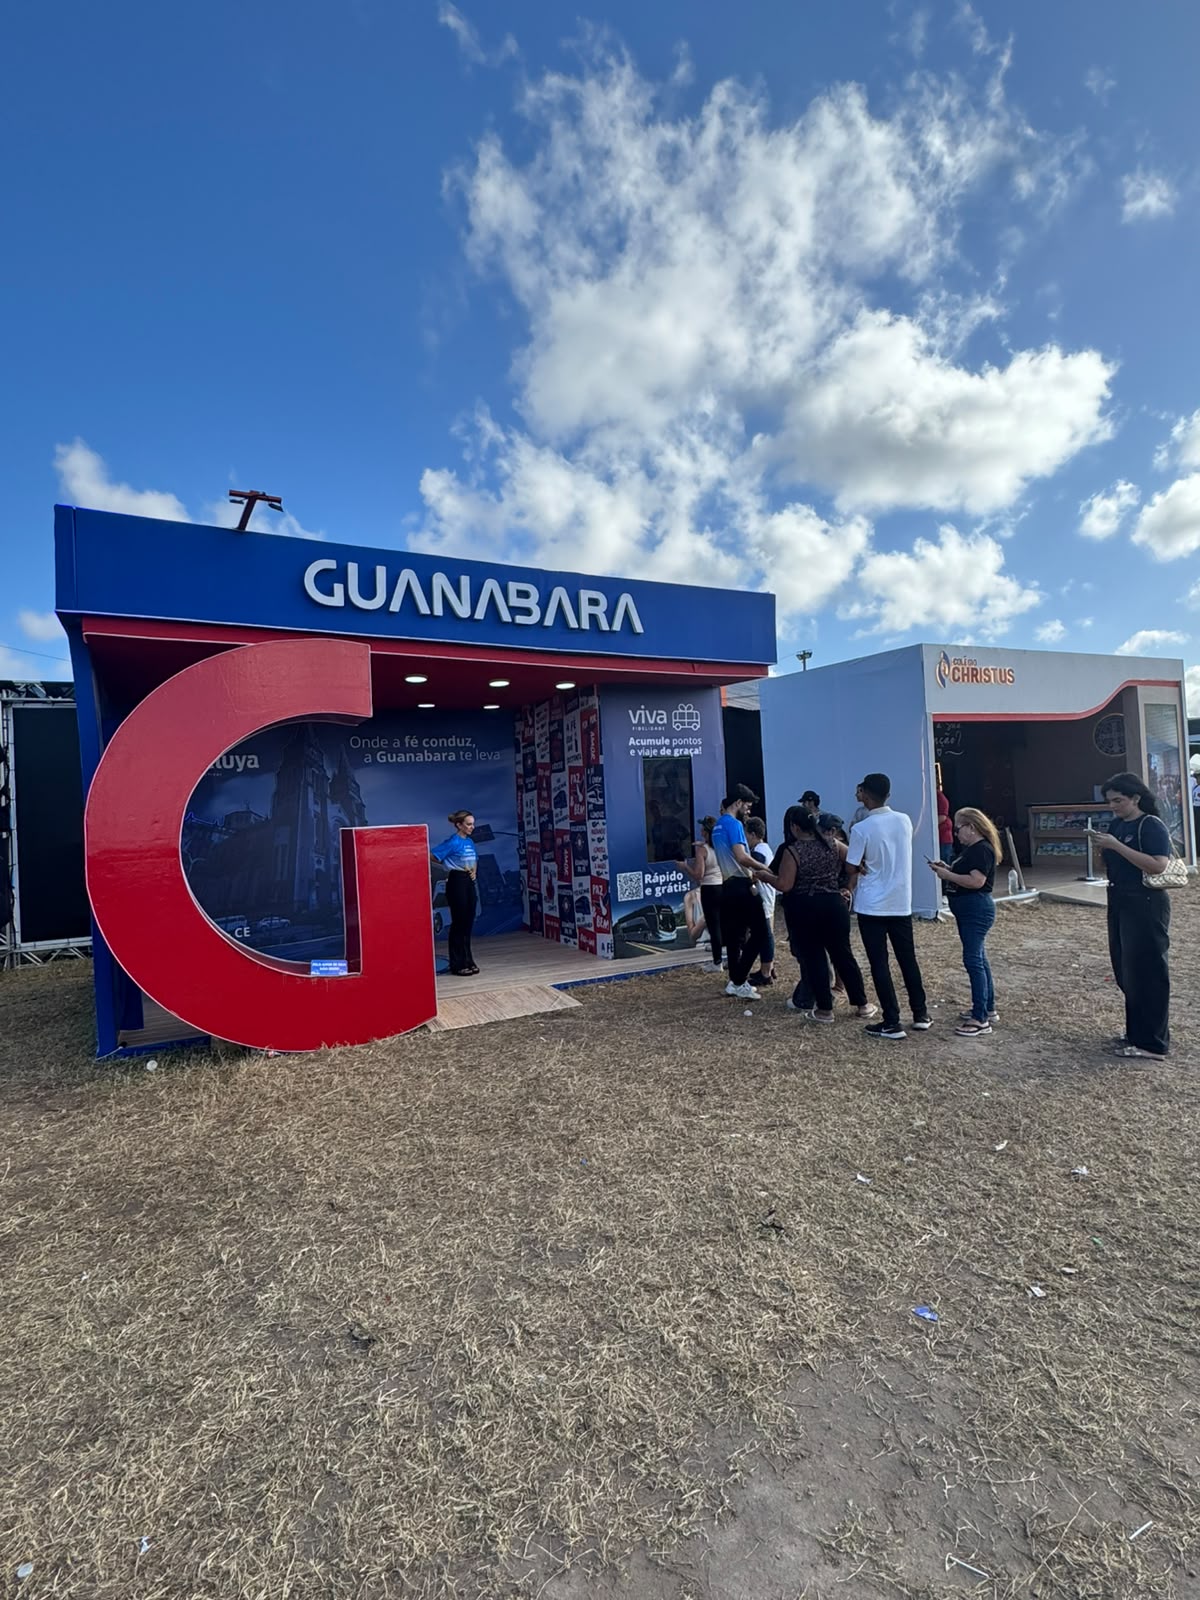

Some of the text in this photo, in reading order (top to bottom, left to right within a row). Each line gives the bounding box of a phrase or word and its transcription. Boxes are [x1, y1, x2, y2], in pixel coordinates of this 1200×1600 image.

[303, 558, 645, 634] GUANABARA
[951, 667, 1016, 685] CHRISTUS
[628, 704, 668, 725] viva
[349, 735, 476, 750] Onde a fé conduz,
[628, 736, 703, 748] Acumule pontos
[363, 748, 501, 763] a Guanabara te leva
[629, 746, 702, 758] e viaje de graça!
[211, 752, 260, 773] luya
[644, 871, 684, 886] Rápido
[644, 882, 692, 900] e grátis!
[234, 926, 252, 939] CE
